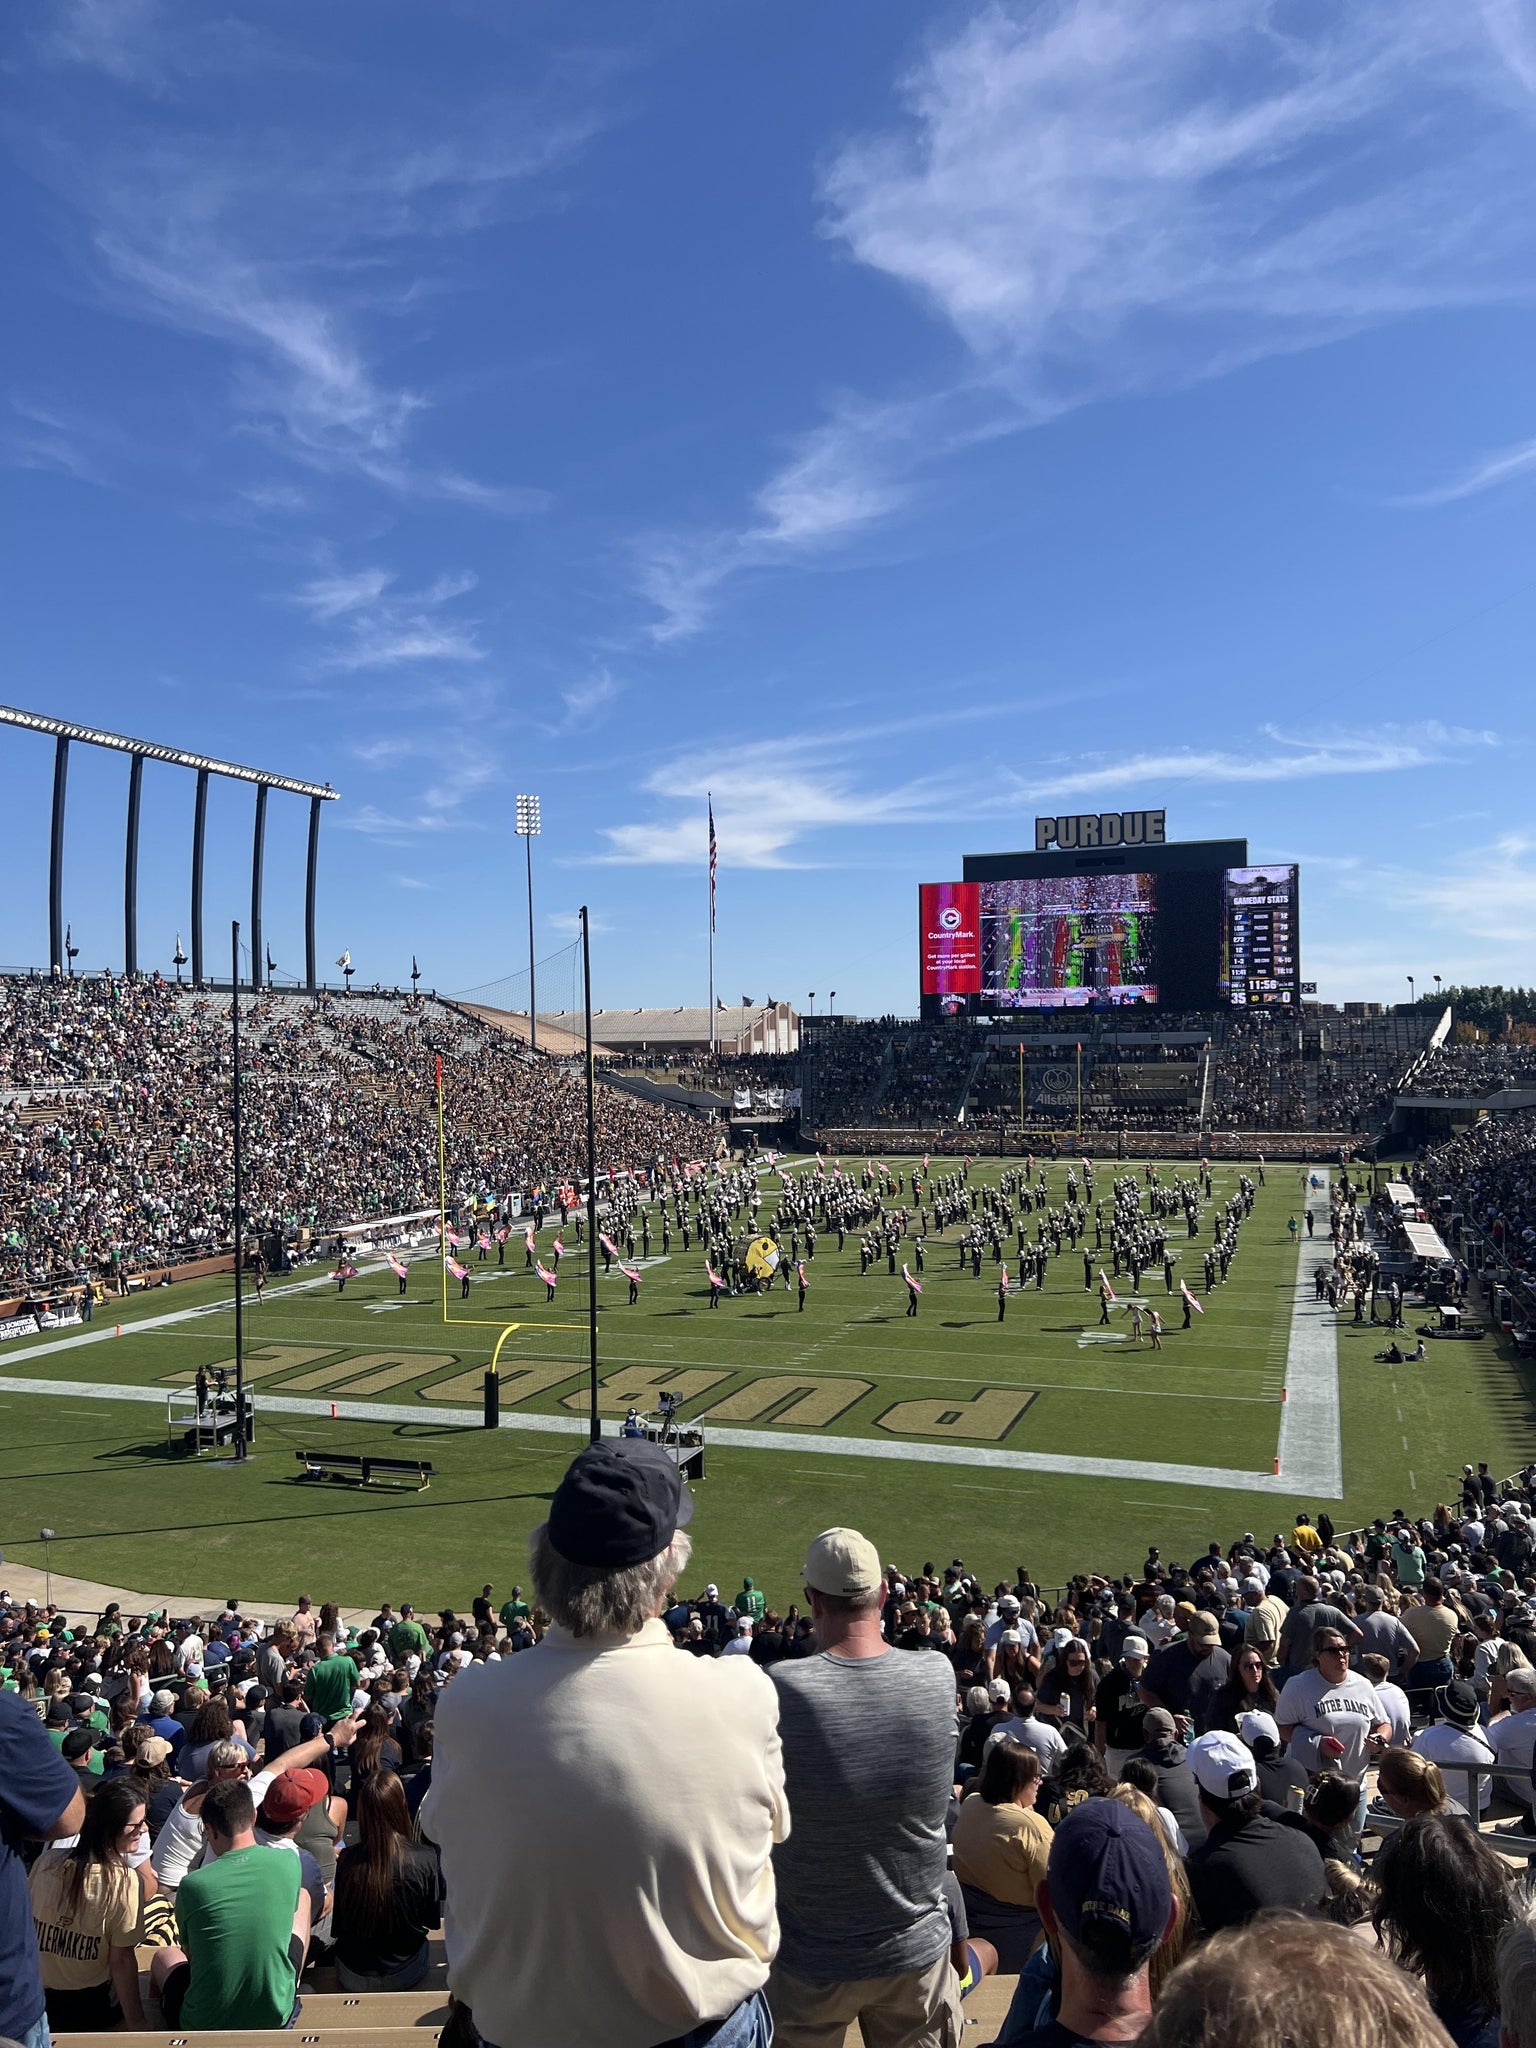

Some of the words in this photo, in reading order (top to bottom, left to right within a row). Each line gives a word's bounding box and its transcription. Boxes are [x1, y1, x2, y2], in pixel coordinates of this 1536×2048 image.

[1036, 811, 1165, 850] PURDUE
[1233, 897, 1266, 905] GAMEDAY
[1267, 896, 1289, 904] STATS
[960, 952, 976, 960] gallon
[1249, 980, 1277, 990] 11:56
[1303, 984, 1315, 993] 25
[1231, 992, 1246, 1004] 35
[1282, 991, 1291, 1003] 0
[1035, 1093, 1080, 1106] Allstate
[156, 1344, 1041, 1442] PURDUE
[746, 1596, 757, 1612] 11
[706, 1615, 719, 1631] 11
[1314, 1699, 1342, 1718] NOTRE
[1344, 1699, 1370, 1718] DAME
